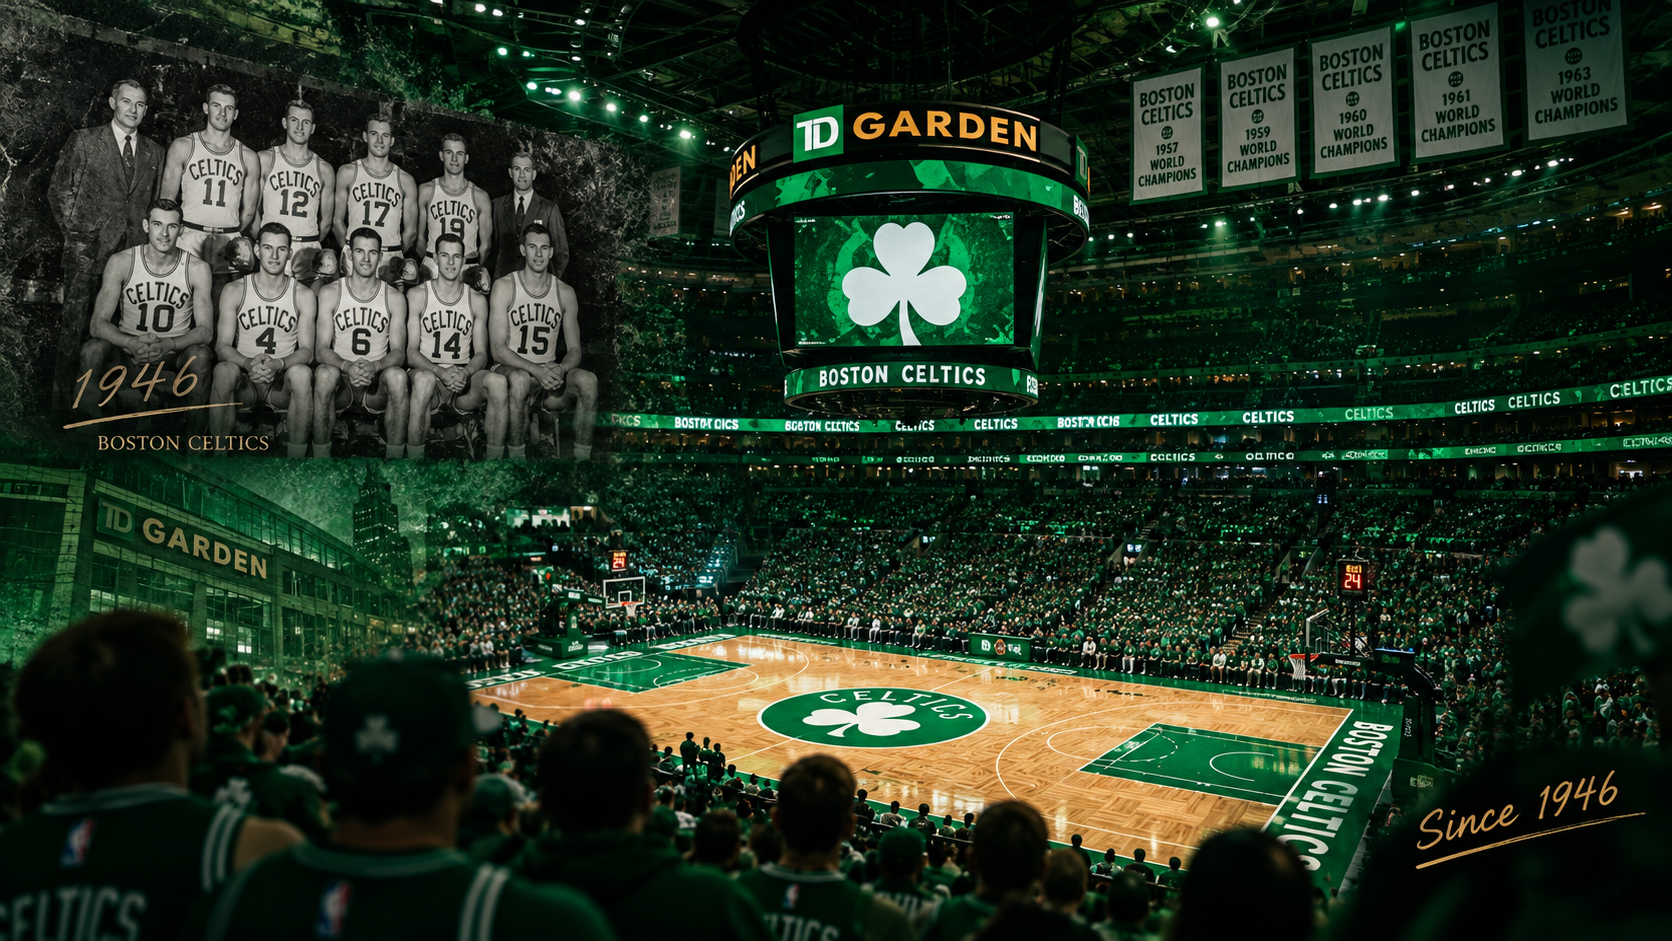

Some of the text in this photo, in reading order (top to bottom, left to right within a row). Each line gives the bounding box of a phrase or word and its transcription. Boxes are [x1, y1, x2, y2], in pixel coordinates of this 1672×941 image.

[1532, 0, 1611, 28] BOSTON
[1419, 19, 1490, 51] BOSTON
[1535, 15, 1611, 49] CELTICS
[1319, 43, 1383, 71] BOSTON
[1422, 41, 1489, 72] CELTICS
[1227, 64, 1287, 90] BOSTON
[1322, 64, 1382, 91] CELTICS
[1558, 66, 1591, 85] 1963
[1139, 83, 1195, 108] BOSTON
[1229, 83, 1286, 109] CELTICS
[1442, 89, 1471, 106] 1961
[1550, 83, 1600, 104] WORLD
[1141, 101, 1193, 125] CELTICS
[1339, 109, 1367, 124] 1960
[1435, 104, 1480, 124] WORLD
[1535, 97, 1618, 124] CHAMPIONS
[796, 110, 1037, 152] TD GARDEN
[1245, 126, 1271, 140] 1959
[1333, 124, 1374, 141] WORLD
[1421, 118, 1495, 143] CHAMPIONS
[1156, 142, 1179, 155] 1957
[1240, 140, 1277, 156] WORLD
[1320, 137, 1387, 158] CHAMPIONS
[189, 158, 243, 186] CELTICS
[730, 145, 756, 200] DEN
[1150, 155, 1185, 171] WORLD
[1227, 152, 1290, 173] CHAMPIONS
[269, 171, 320, 198] CELTICS
[1138, 167, 1196, 187] CHAMPIONS
[202, 178, 226, 207] 11
[279, 189, 308, 218] 12
[352, 182, 401, 207] CELTICS
[362, 200, 390, 227] 17
[430, 200, 475, 224] CELTICS
[439, 217, 465, 241] 19
[126, 281, 189, 309] CELTICS
[136, 303, 175, 333] 10
[239, 306, 296, 333] CELTICS
[335, 307, 389, 333] CELTICS
[422, 310, 472, 336] CELTICS
[510, 303, 562, 329] CELTICS
[255, 328, 276, 354] 4
[352, 328, 371, 356] 6
[432, 331, 461, 359] 14
[517, 325, 550, 355] 15
[819, 364, 986, 387] BOSTON CELTICS
[1344, 407, 1394, 420] CELTICS
[1454, 399, 1495, 414] CELTICS
[1508, 391, 1561, 409] CELTICS
[974, 418, 1018, 430] CELTICS
[1150, 413, 1199, 426] CELTICS
[1242, 411, 1295, 423] CELTICS
[102, 502, 267, 579] TD GARDEN
[1344, 573, 1361, 589] 24
[819, 690, 973, 720] CELTICS
[1322, 721, 1394, 777] BOSTON
